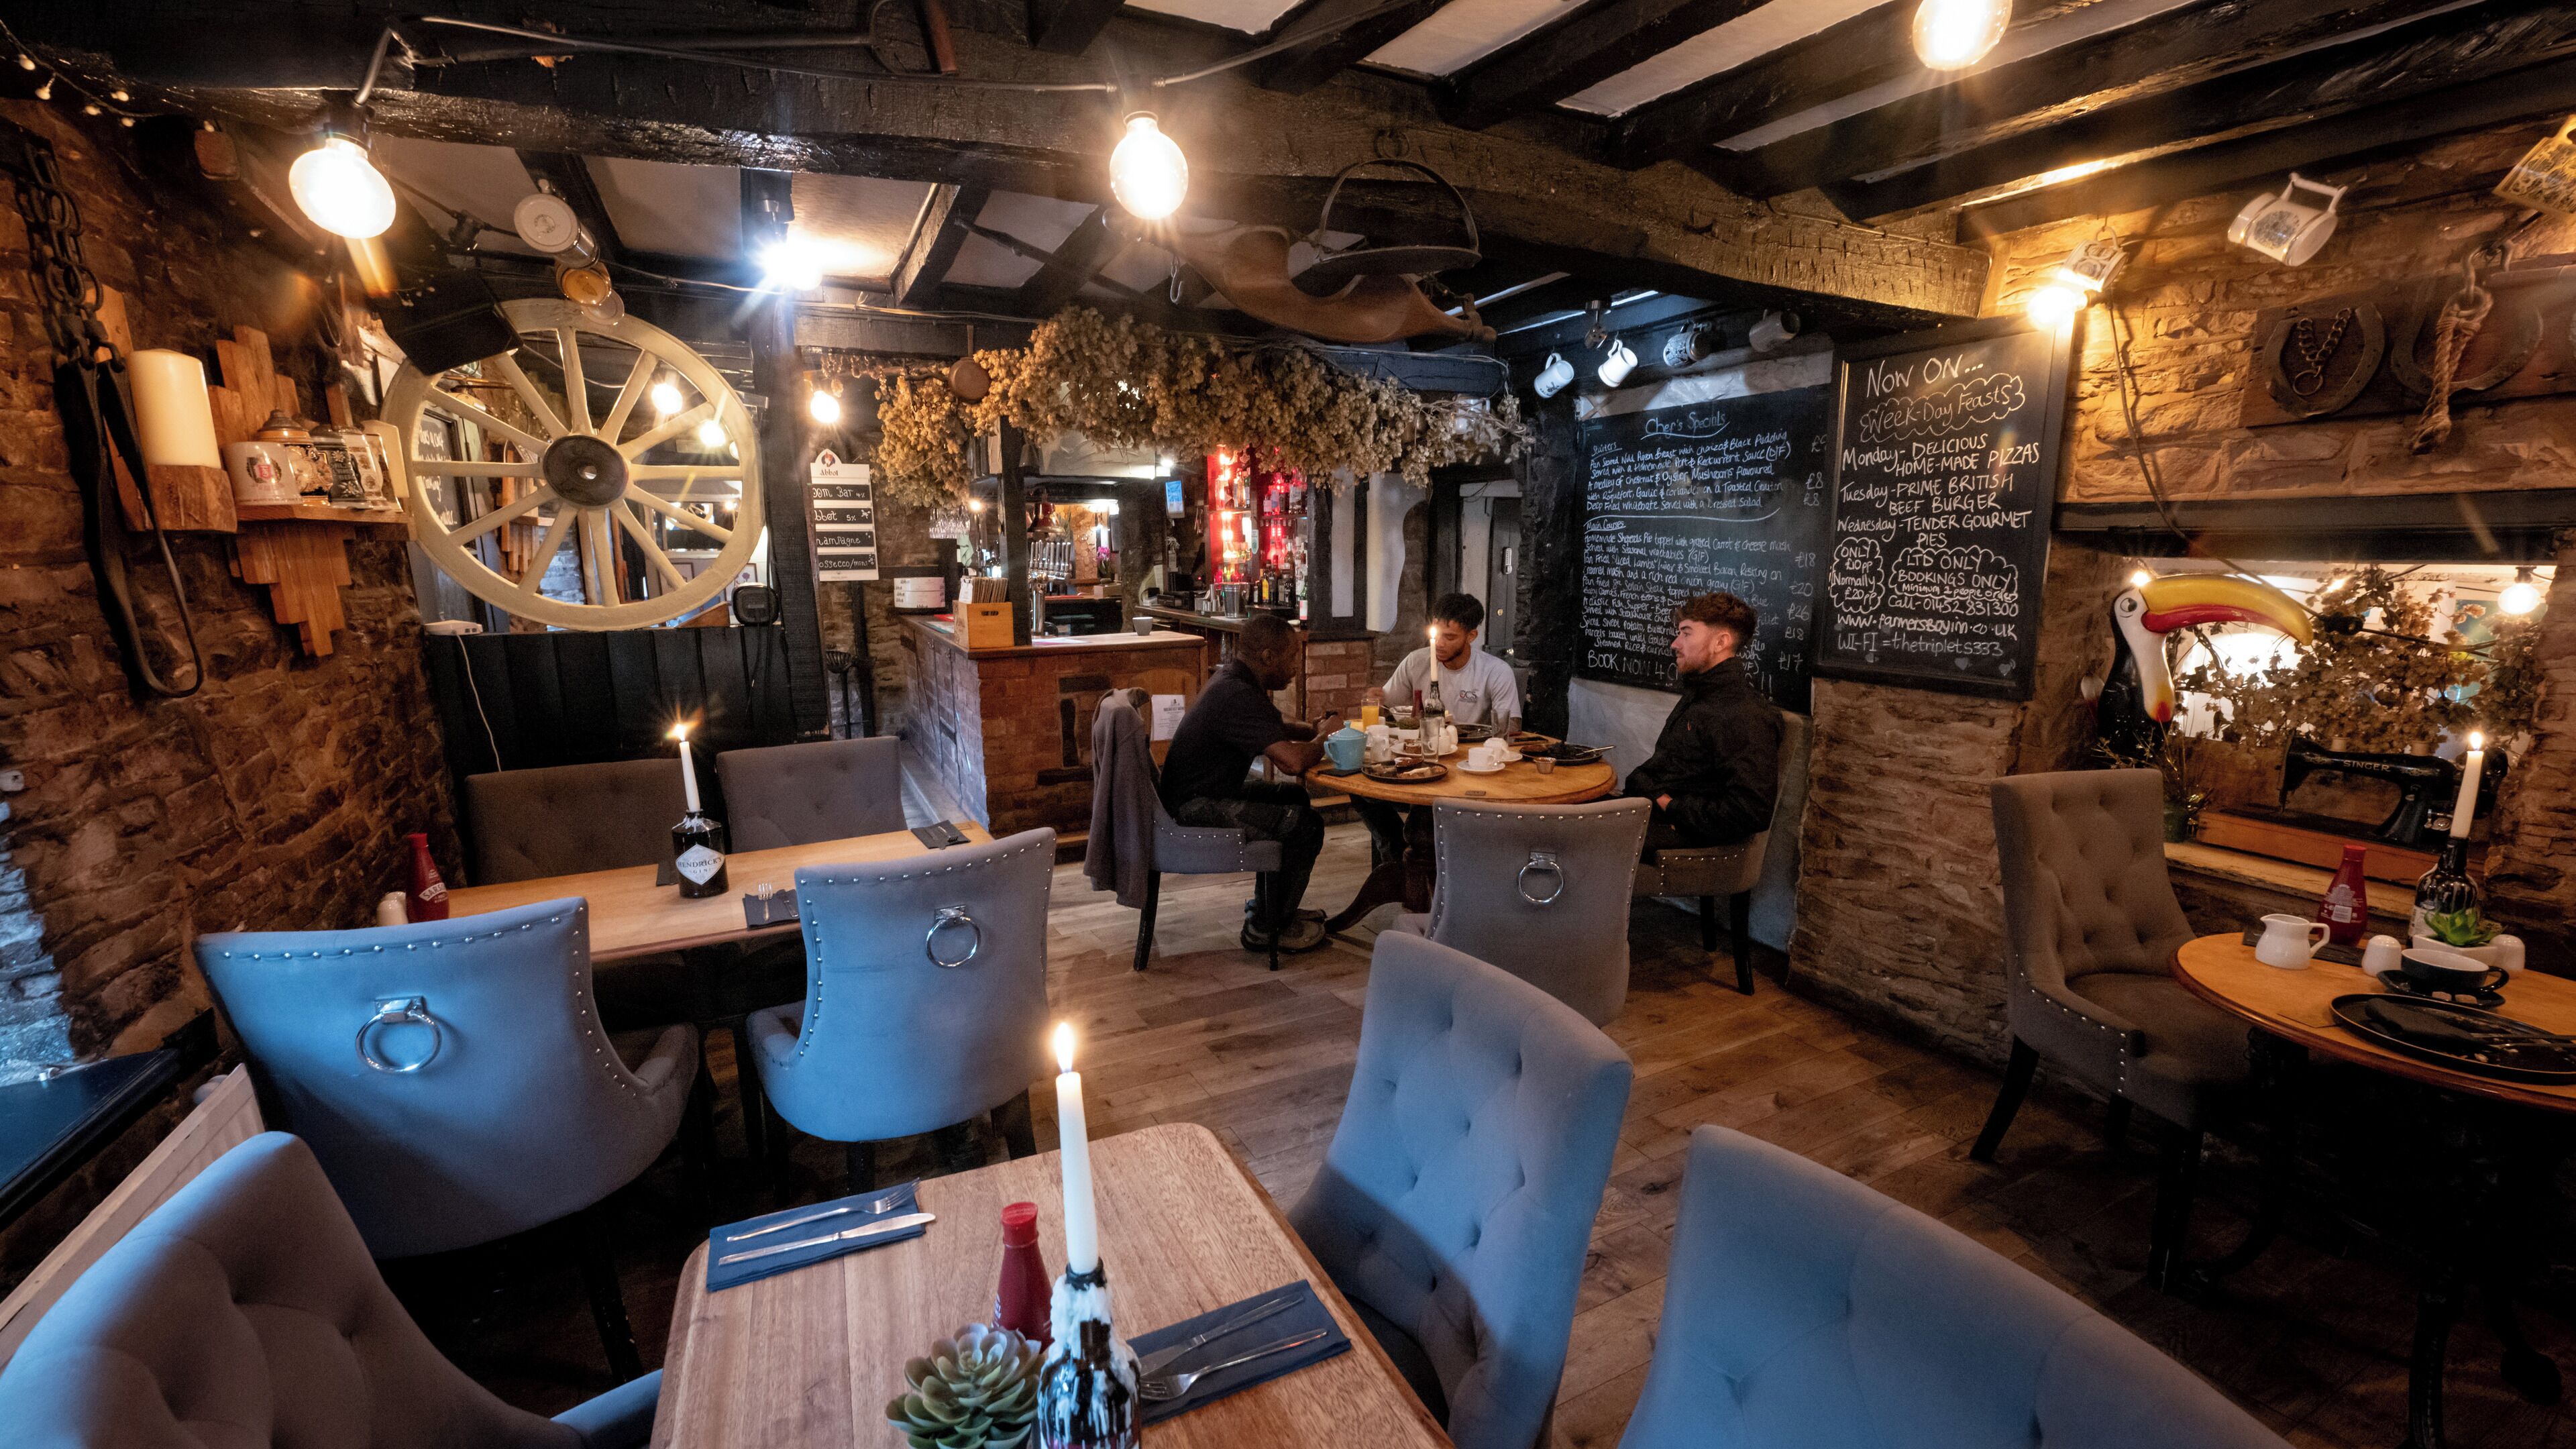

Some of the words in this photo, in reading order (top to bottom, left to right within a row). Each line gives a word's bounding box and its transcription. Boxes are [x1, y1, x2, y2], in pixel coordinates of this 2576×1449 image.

[1646, 417, 1682, 435] Chef's
[1591, 460, 1601, 470] Pan
[1679, 444, 1694, 456] with
[1729, 437, 1751, 450] Black
[1755, 428, 1788, 447] Pudding
[1913, 433, 1989, 460] DELICIOUS
[1895, 453, 1979, 477] HOME-MADE
[1987, 442, 2039, 469] PIZZAS
[1612, 466, 1625, 475] with
[1588, 481, 1593, 490] A
[1594, 476, 1615, 494] medley
[1615, 475, 1624, 488] of
[1692, 467, 1733, 481] Mushrooms
[1805, 471, 1823, 490] £8
[1948, 473, 2014, 495] BRITISH
[1587, 492, 1601, 501] with
[1587, 501, 1603, 511] Deep
[1683, 498, 1698, 510] with
[1803, 492, 1820, 506] £8
[1889, 500, 1924, 516] BEEF
[1931, 492, 2001, 513] BURGER
[814, 510, 838, 521] bbot
[1587, 522, 1602, 530] Main
[1603, 519, 1625, 530] Courses
[1962, 510, 2033, 531] GOURMET
[1644, 531, 1652, 543] Pie
[1675, 535, 1688, 547] with
[1917, 533, 1947, 548] PIES
[1841, 543, 1870, 558] ONLY
[1794, 552, 1816, 569] £18
[1907, 554, 1933, 566] LTD
[1940, 554, 1982, 572] ONLY
[1582, 576, 1595, 587] Pan
[1627, 569, 1638, 580] and
[1641, 571, 1647, 580] a
[1666, 574, 1678, 584] red
[1834, 572, 1876, 592] Normally
[1898, 570, 1965, 586] BOOKINGS
[1972, 573, 2011, 592] ONLY
[1788, 581, 1813, 596] £20
[1845, 587, 1877, 605] £20pp
[1902, 583, 1939, 594] Minimum
[1943, 586, 1953, 594] 2
[1953, 588, 1984, 600] people
[1787, 602, 1809, 621] £26
[1923, 598, 1964, 614] 01452
[1966, 600, 2019, 616] 831300
[1785, 626, 1804, 641] £18
[1838, 632, 1878, 651] WI-FI
[1588, 649, 1619, 671] BOOK
[1778, 651, 1804, 673] £17
[2343, 759, 2391, 772] SINGER
[678, 857, 722, 868] HENDRICK'S
